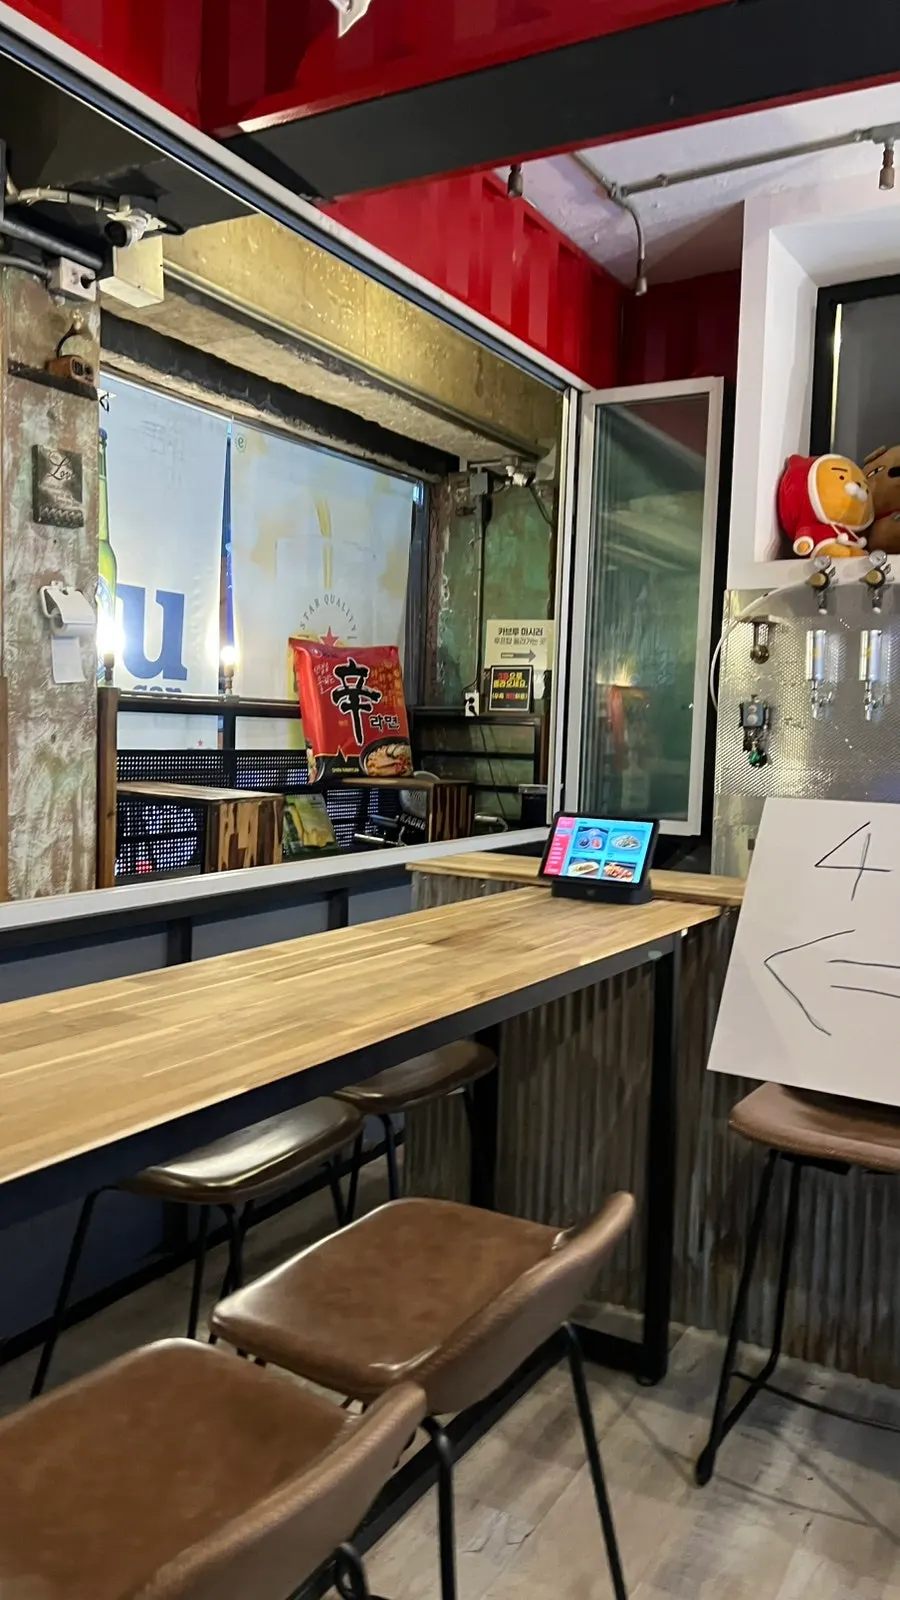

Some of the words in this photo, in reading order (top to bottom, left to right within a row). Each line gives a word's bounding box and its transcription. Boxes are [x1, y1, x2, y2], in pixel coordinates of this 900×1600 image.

[300, 598, 320, 630] STAR
[323, 594, 357, 631] QUALITY
[521, 627, 543, 637] 마시러
[331, 657, 382, 746] 辛
[369, 713, 399, 732] 라면
[814, 821, 892, 902] 4
